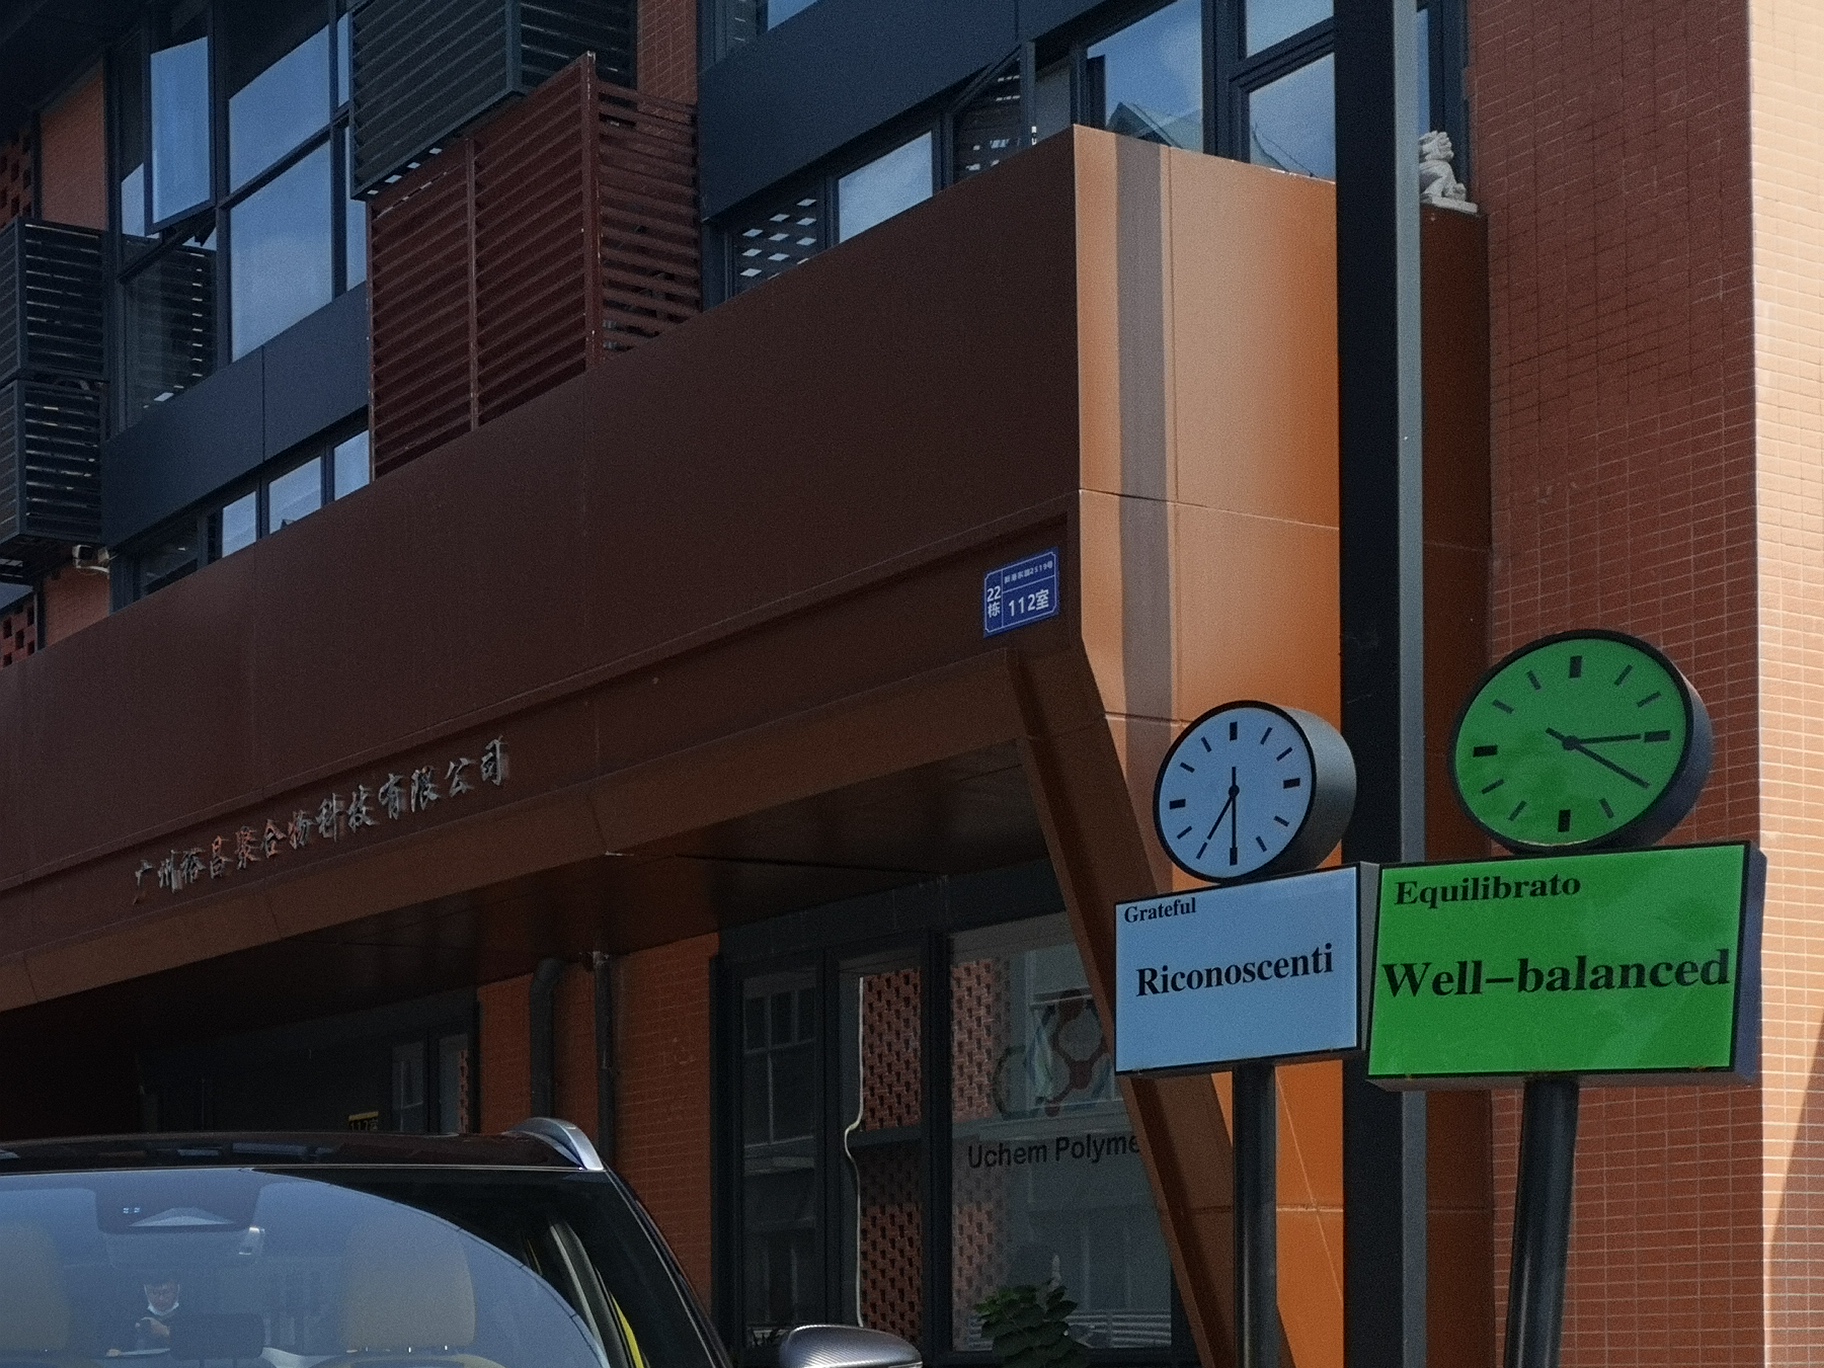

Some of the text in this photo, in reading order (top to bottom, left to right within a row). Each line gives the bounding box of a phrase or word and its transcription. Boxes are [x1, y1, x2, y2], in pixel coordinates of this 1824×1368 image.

[1008, 588, 1050, 617] 112室
[1393, 871, 1582, 910] Equilibrato
[1123, 897, 1197, 924] Grateful
[1135, 942, 1335, 997] Riconoscenti
[968, 1139, 1048, 1169] Uchem
